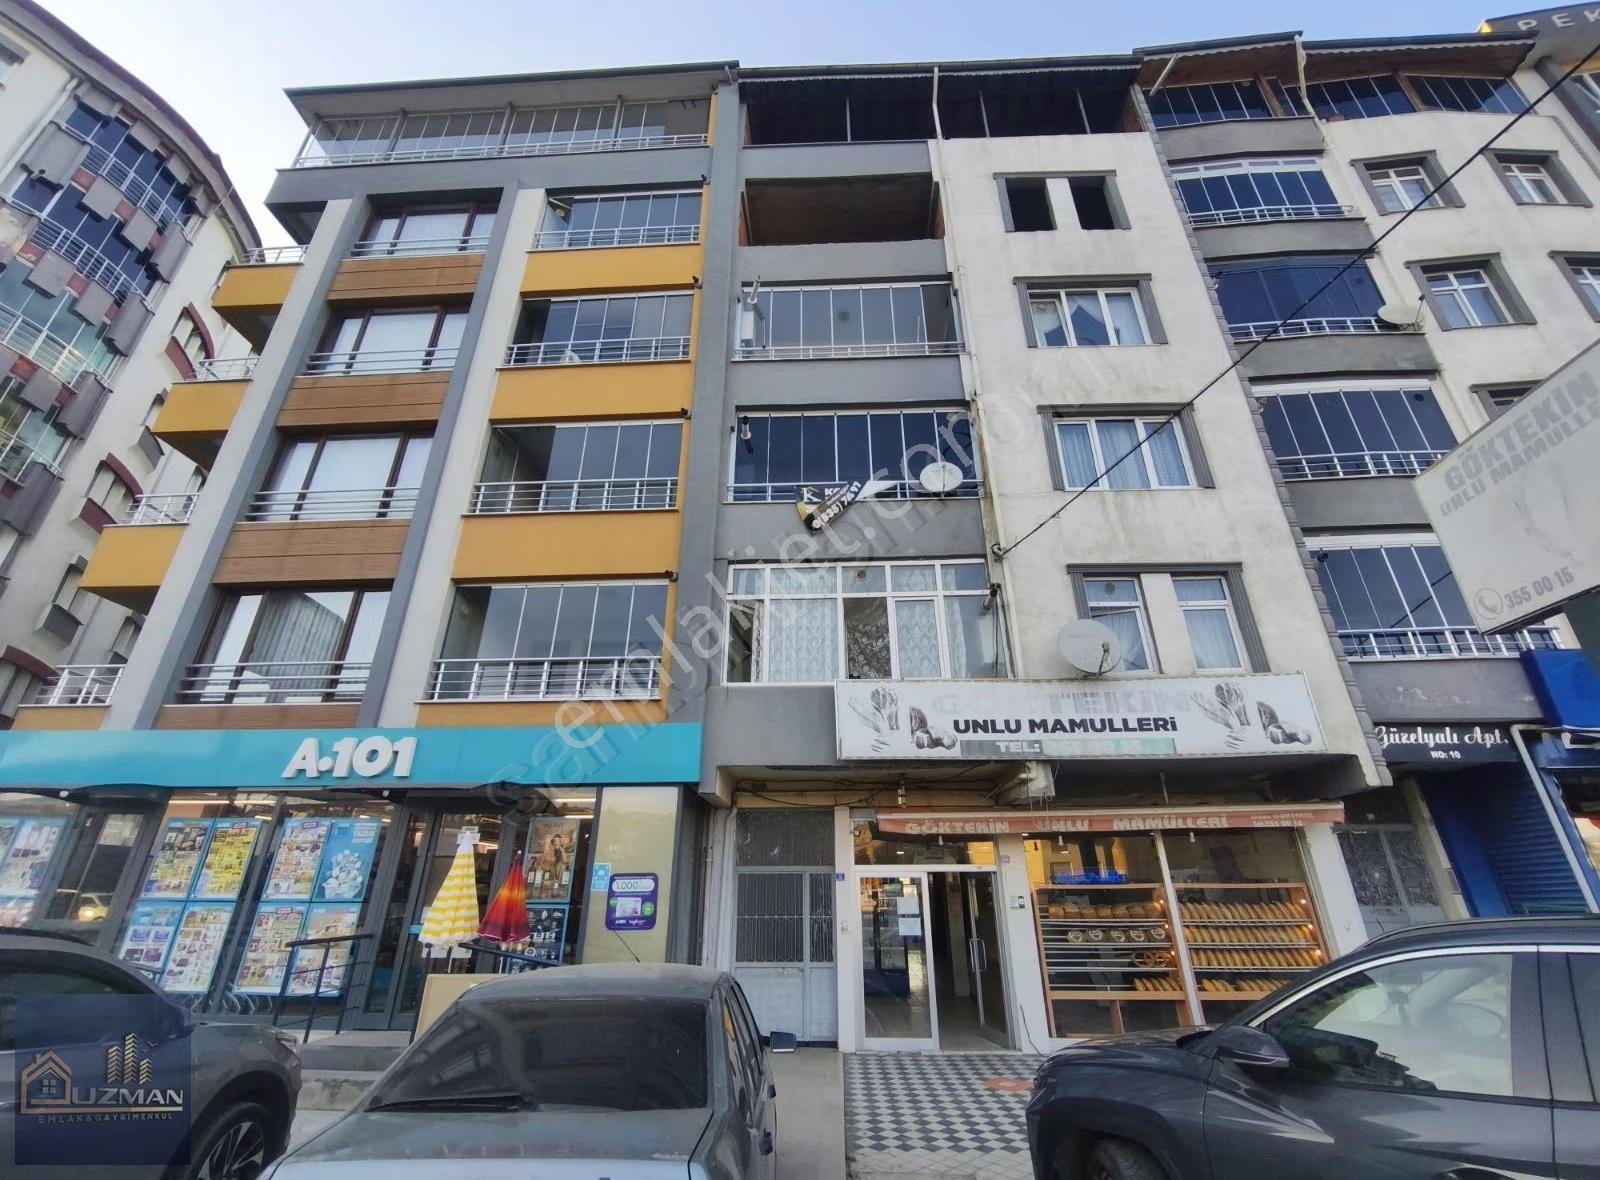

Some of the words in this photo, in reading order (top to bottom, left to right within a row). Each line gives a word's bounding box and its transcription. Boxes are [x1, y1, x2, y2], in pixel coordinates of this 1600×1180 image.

[1440, 478, 1487, 517] UNLU
[1503, 585, 1533, 610] 355
[1532, 575, 1554, 597] 00
[1554, 566, 1575, 588] 15
[953, 718, 1022, 734] UNLU
[1430, 751, 1448, 759] NO:
[1450, 751, 1461, 759] 10
